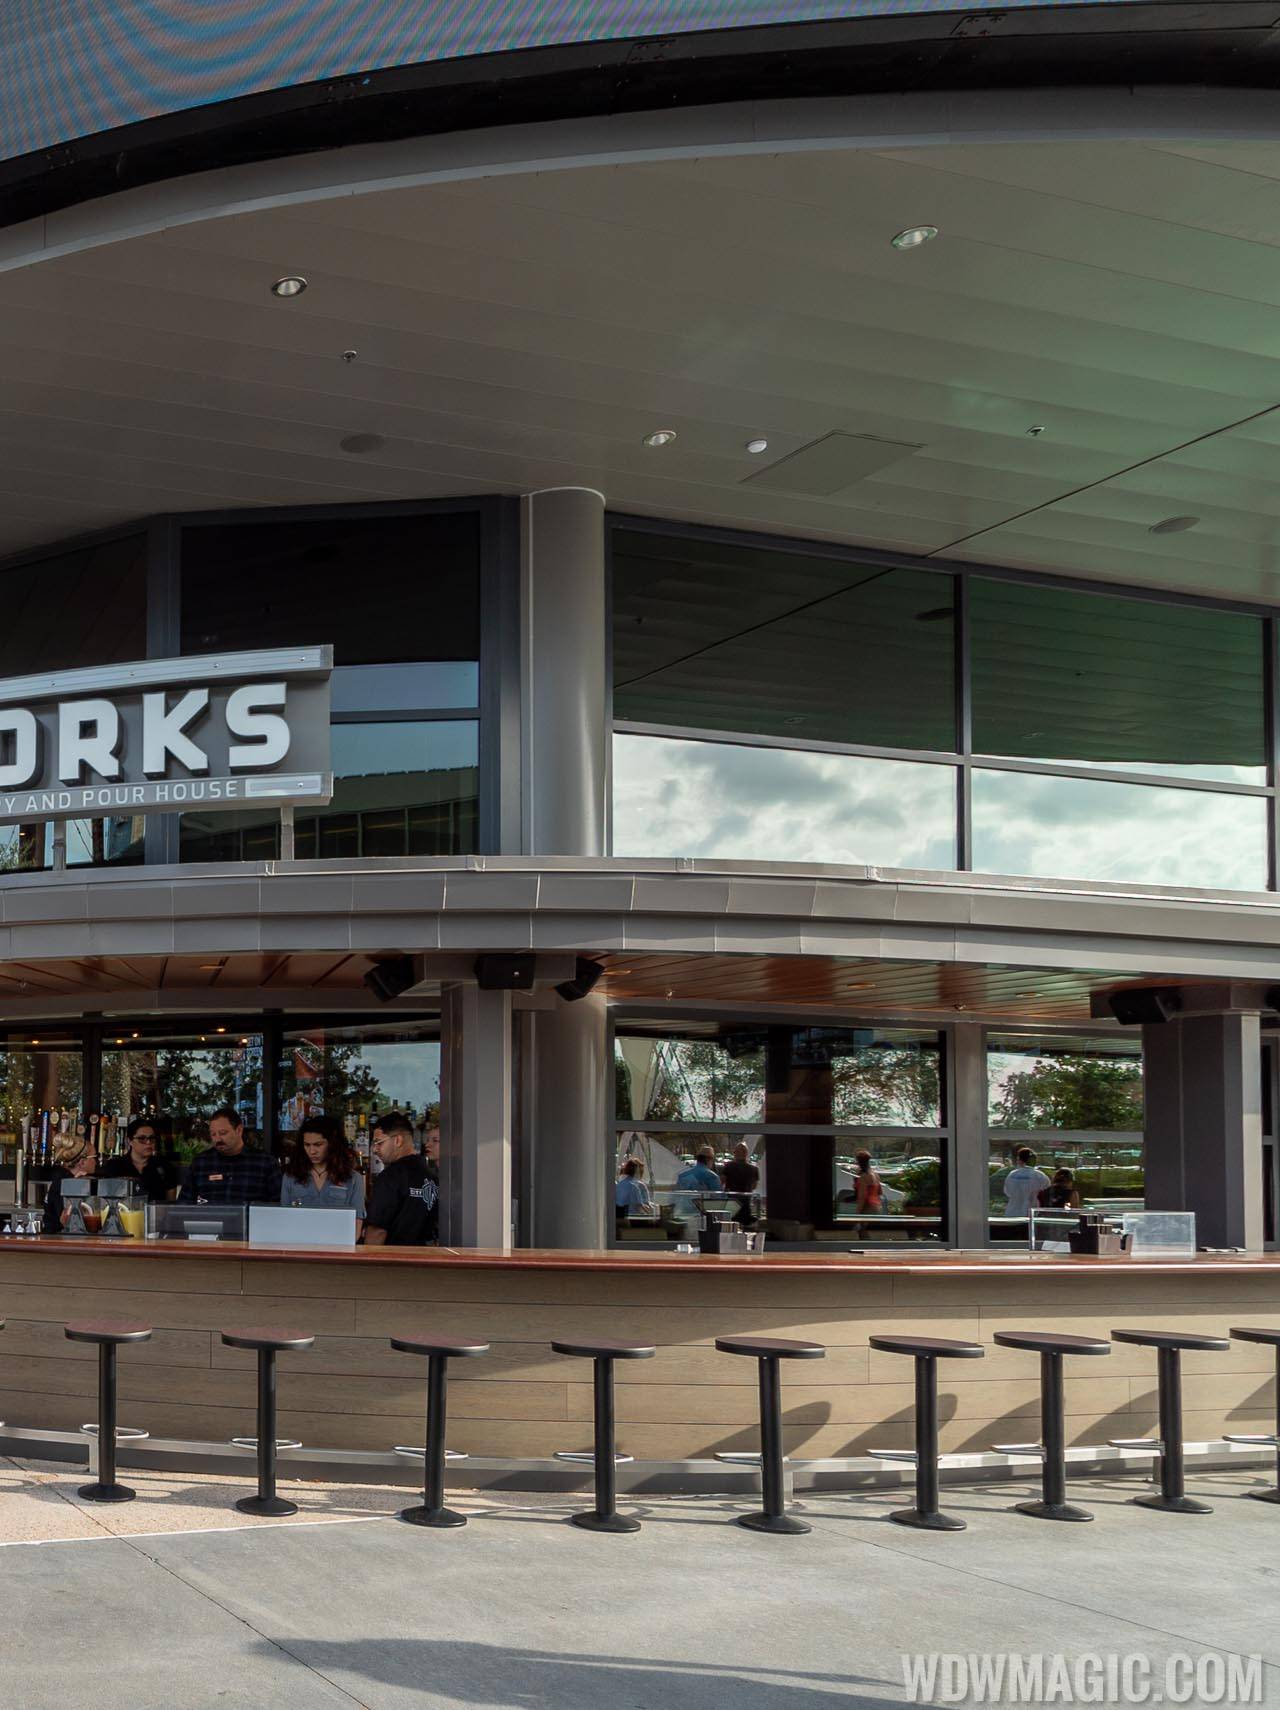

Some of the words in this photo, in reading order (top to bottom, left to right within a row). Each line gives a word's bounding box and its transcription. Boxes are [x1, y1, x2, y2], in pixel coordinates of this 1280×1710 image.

[26, 791, 72, 812] AND
[82, 786, 145, 808] POUR
[155, 780, 239, 802] HOUSE
